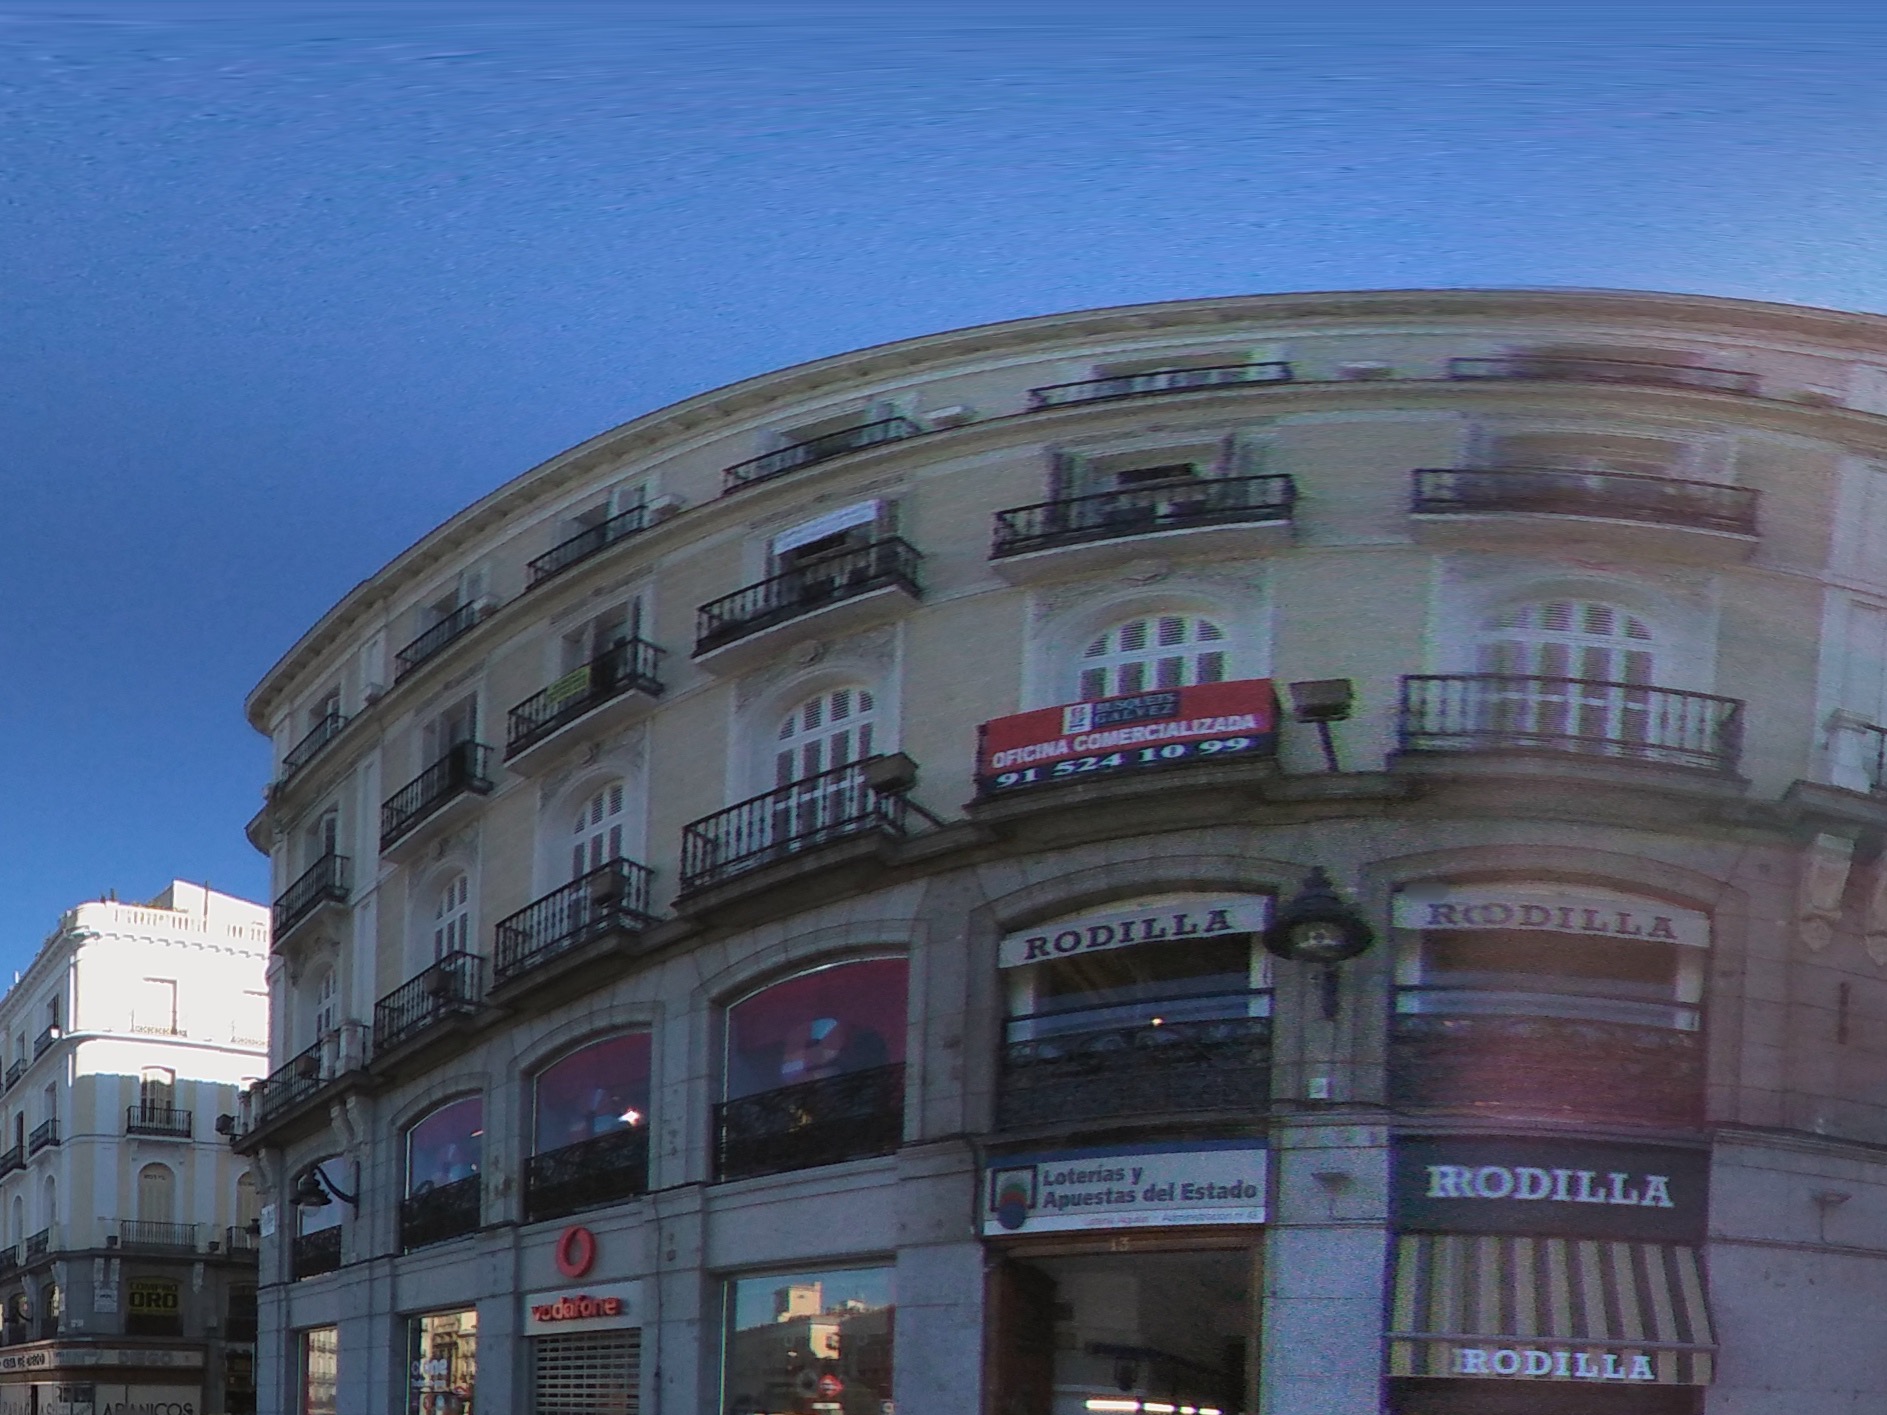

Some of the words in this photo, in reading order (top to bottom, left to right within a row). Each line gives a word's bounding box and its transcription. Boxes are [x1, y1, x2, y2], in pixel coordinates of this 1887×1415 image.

[992, 739, 1068, 769] OFICINA
[1073, 714, 1257, 751] COMERCIALIZADA
[996, 767, 1040, 788] 91
[1051, 753, 1124, 776] 524
[1139, 744, 1186, 762] 10
[1197, 737, 1251, 755] 99
[1024, 909, 1235, 960] RODILLA
[1428, 902, 1678, 940] RODILLA
[1130, 1167, 1143, 1186] y
[1426, 1165, 1676, 1208] RODILLA
[1042, 1187, 1136, 1211] Apuestas
[1142, 1182, 1175, 1202] del
[1181, 1179, 1258, 1201] Estado
[129, 1292, 179, 1309] ORO
[130, 1282, 178, 1292] COMPRO
[532, 1295, 623, 1322] vodafone
[1452, 1348, 1656, 1381] RODILLA
